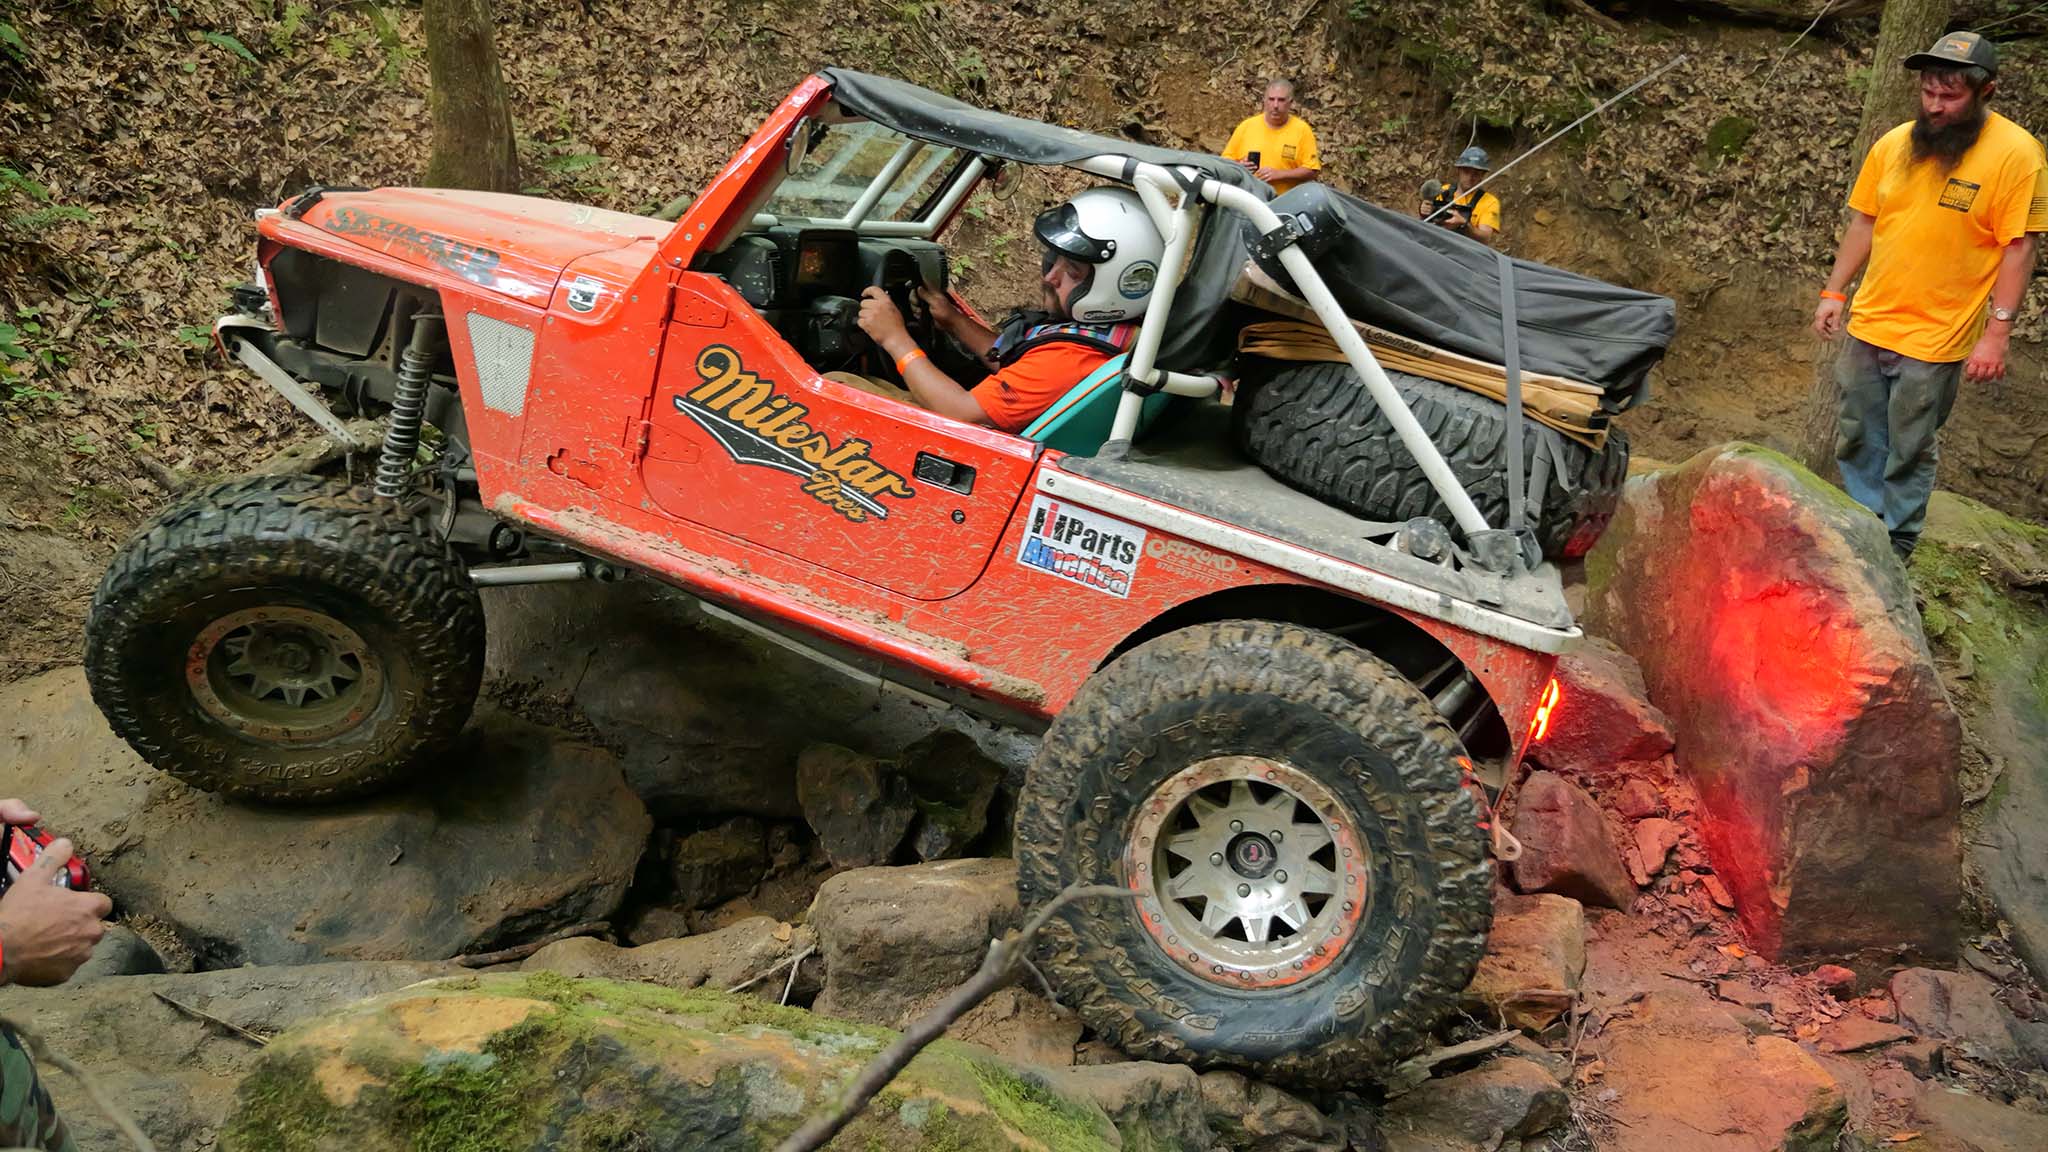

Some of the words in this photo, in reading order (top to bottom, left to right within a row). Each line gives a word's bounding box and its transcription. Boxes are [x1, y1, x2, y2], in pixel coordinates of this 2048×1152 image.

[1364, 327, 1422, 353] Coleman
[687, 345, 914, 498] Milestar
[802, 469, 866, 522] Tires
[1020, 535, 1129, 596] America
